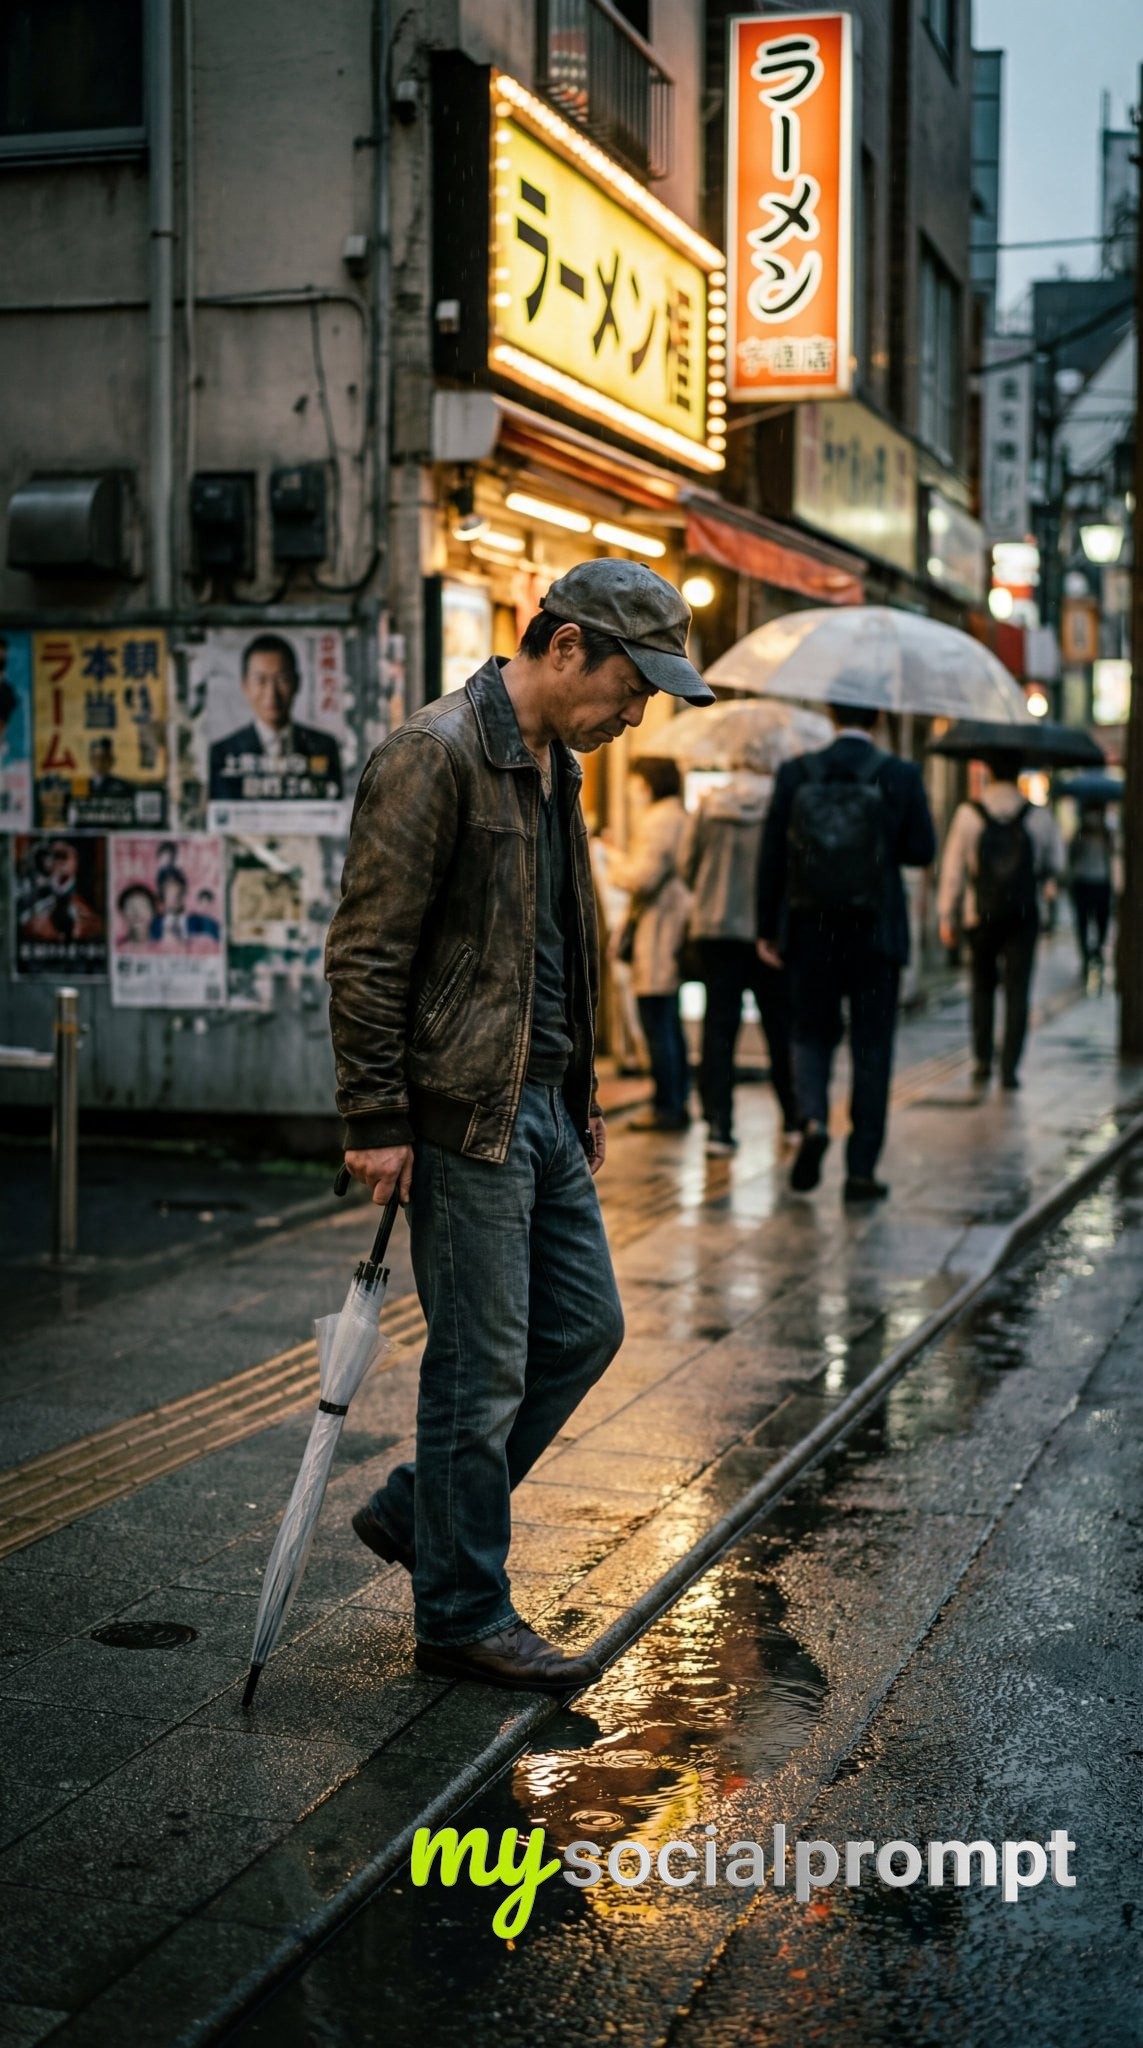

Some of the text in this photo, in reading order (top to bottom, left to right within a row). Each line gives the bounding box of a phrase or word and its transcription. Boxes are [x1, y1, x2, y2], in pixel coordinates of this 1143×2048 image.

[755, 37, 819, 318] ラーメン
[40, 641, 77, 773] ラーム
